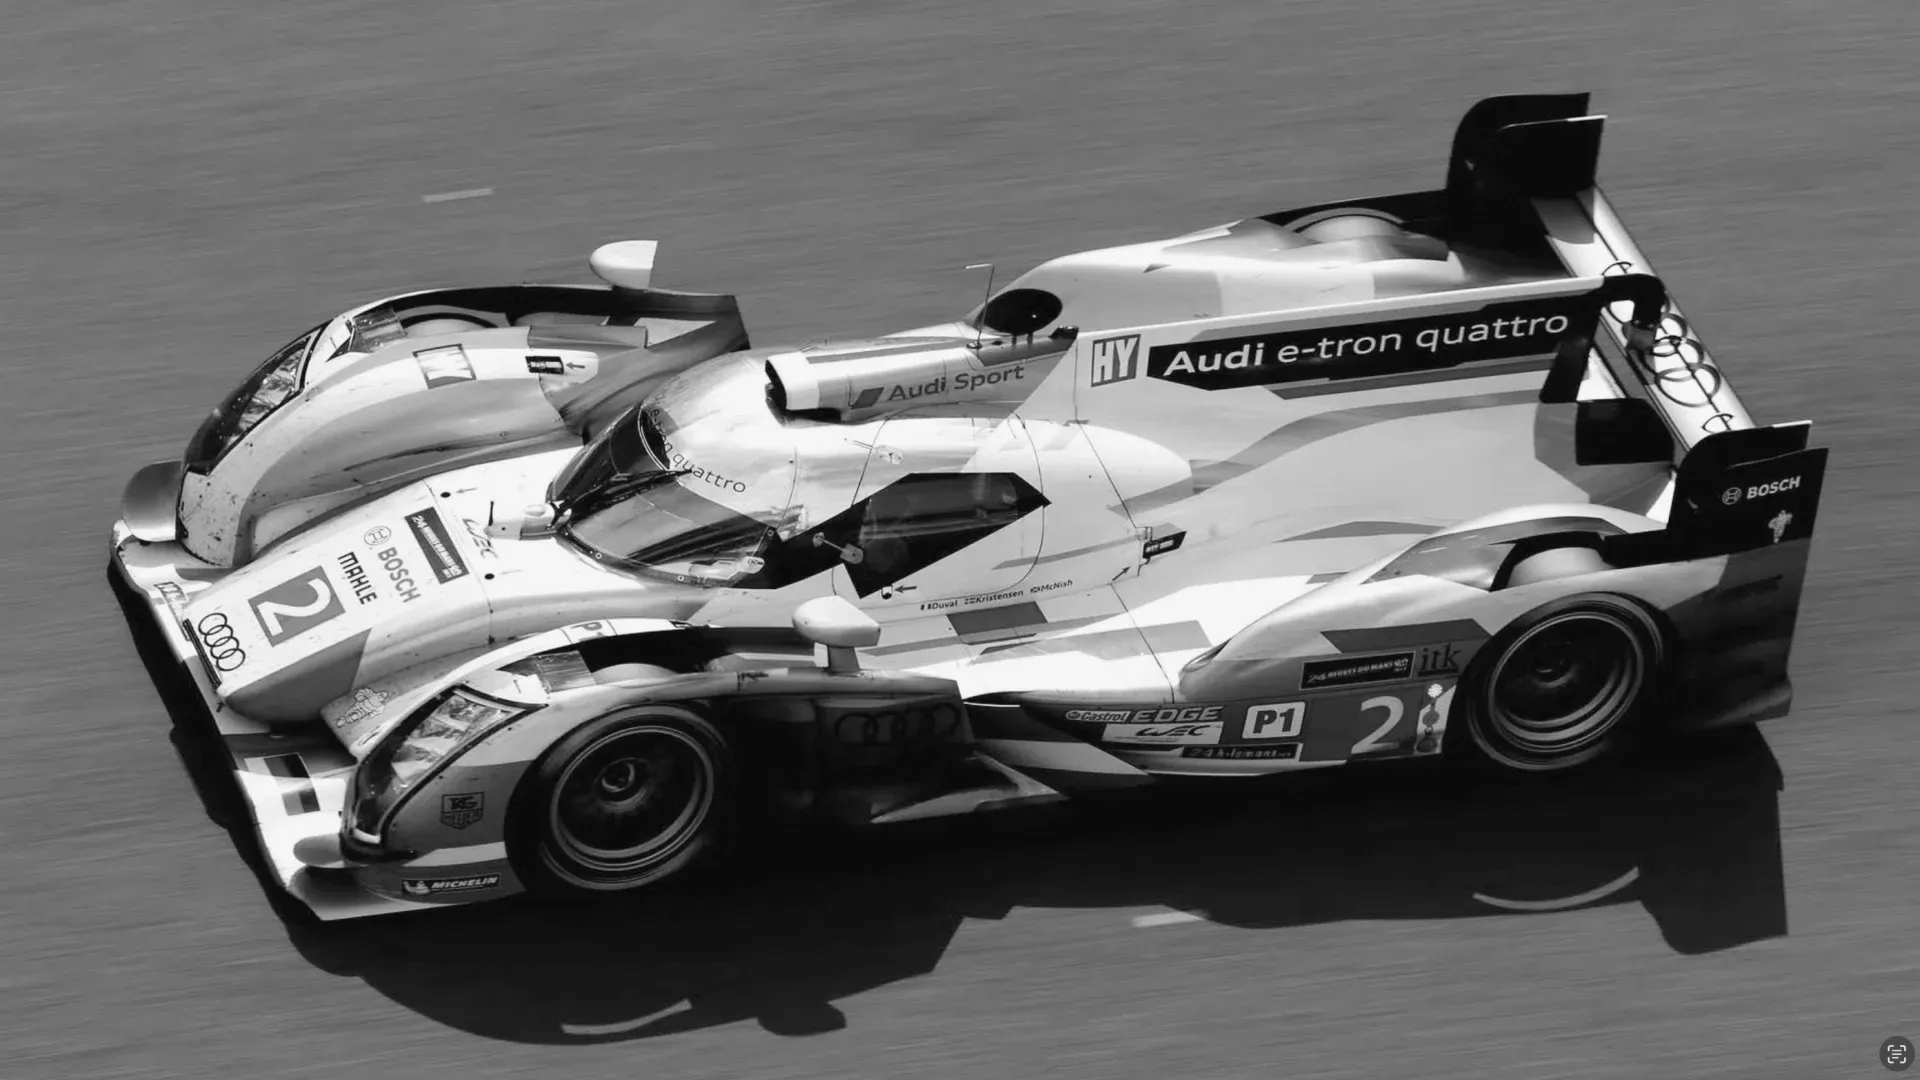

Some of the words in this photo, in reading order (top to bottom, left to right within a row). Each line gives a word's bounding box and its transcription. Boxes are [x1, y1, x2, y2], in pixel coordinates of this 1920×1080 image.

[1093, 337, 1138, 383] HY
[1163, 342, 1265, 377] Audi
[1277, 333, 1402, 364] e-tron
[1416, 305, 1568, 352] quattro
[888, 377, 947, 401] Audi
[954, 366, 1025, 391] Sport
[672, 453, 746, 493] quattro
[1747, 475, 1801, 499] BOSCH
[338, 551, 377, 604] MAHLE
[377, 546, 421, 603] BOSCH
[931, 600, 958, 610] Duval
[975, 589, 1024, 604] Kristensen
[1040, 579, 1073, 592] McNish
[256, 577, 332, 636] 2
[1081, 710, 1127, 722] Castrol
[1131, 706, 1225, 723] EDGE
[1252, 707, 1295, 734] P1
[1351, 696, 1404, 754] 2
[431, 876, 498, 889] MICHELIN
